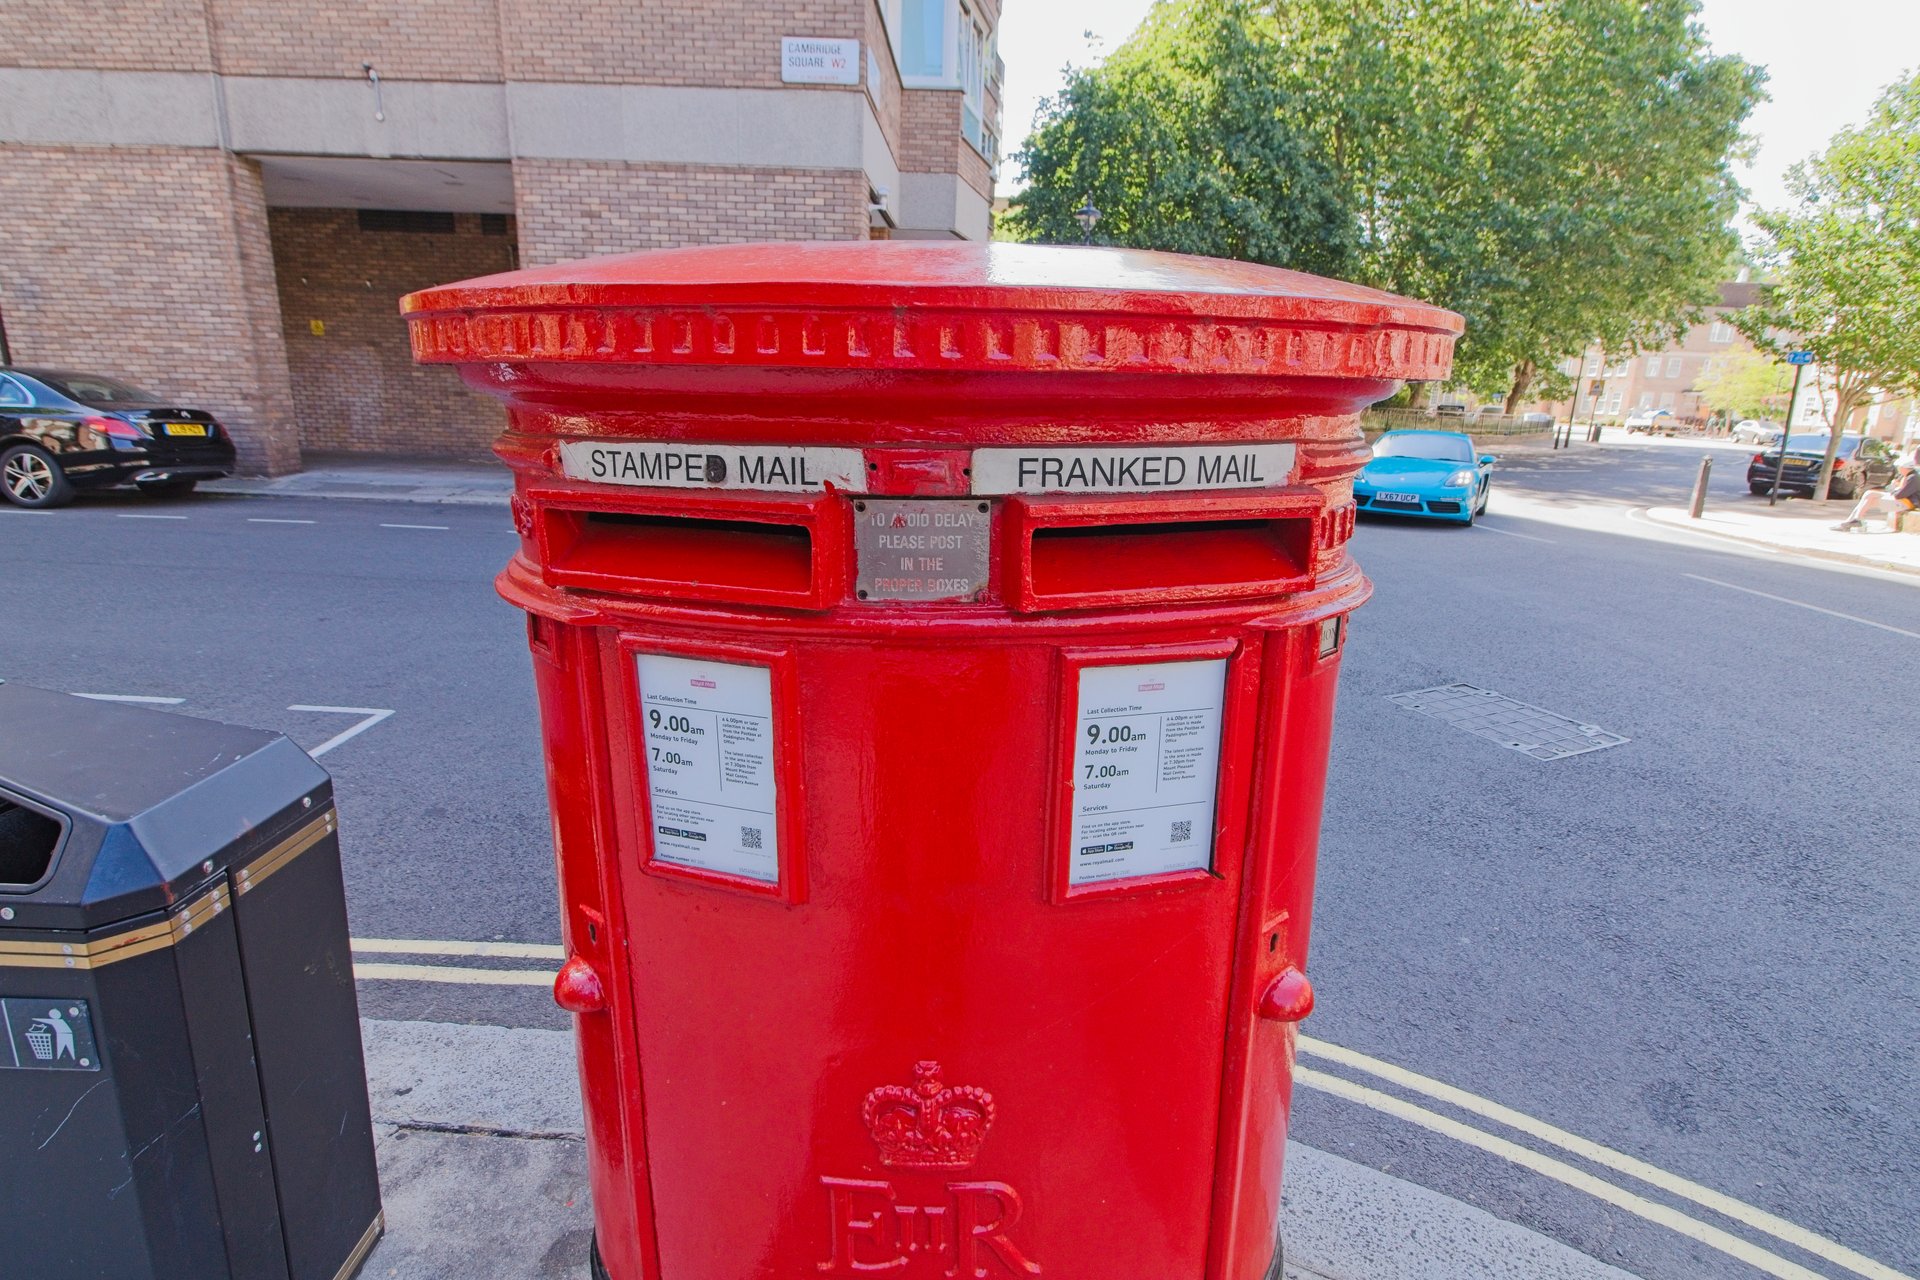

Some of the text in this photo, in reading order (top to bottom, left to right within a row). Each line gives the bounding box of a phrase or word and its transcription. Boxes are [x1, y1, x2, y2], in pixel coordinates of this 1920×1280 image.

[789, 43, 841, 54] CAMBRIDGE
[789, 57, 846, 68] SQUARE W2
[592, 450, 818, 486] STAMPED MAIL
[1018, 454, 1264, 488] FRANKED MAIL
[870, 513, 885, 527] TO
[935, 514, 974, 527] DELAY
[879, 536, 963, 549] PLEASE POST
[901, 558, 944, 571] IN THE
[874, 578, 968, 592] PROPER BOXES
[650, 709, 704, 735] 9.00am
[650, 732, 673, 742] Monday
[680, 737, 698, 746] Friday
[1087, 724, 1146, 744] 9.00am
[652, 747, 693, 766] 7.00am
[653, 766, 677, 775] Saturday
[1085, 765, 1129, 779] 7.00am
[655, 787, 678, 796] Services
[1080, 858, 1124, 866] www.royalmail.com
